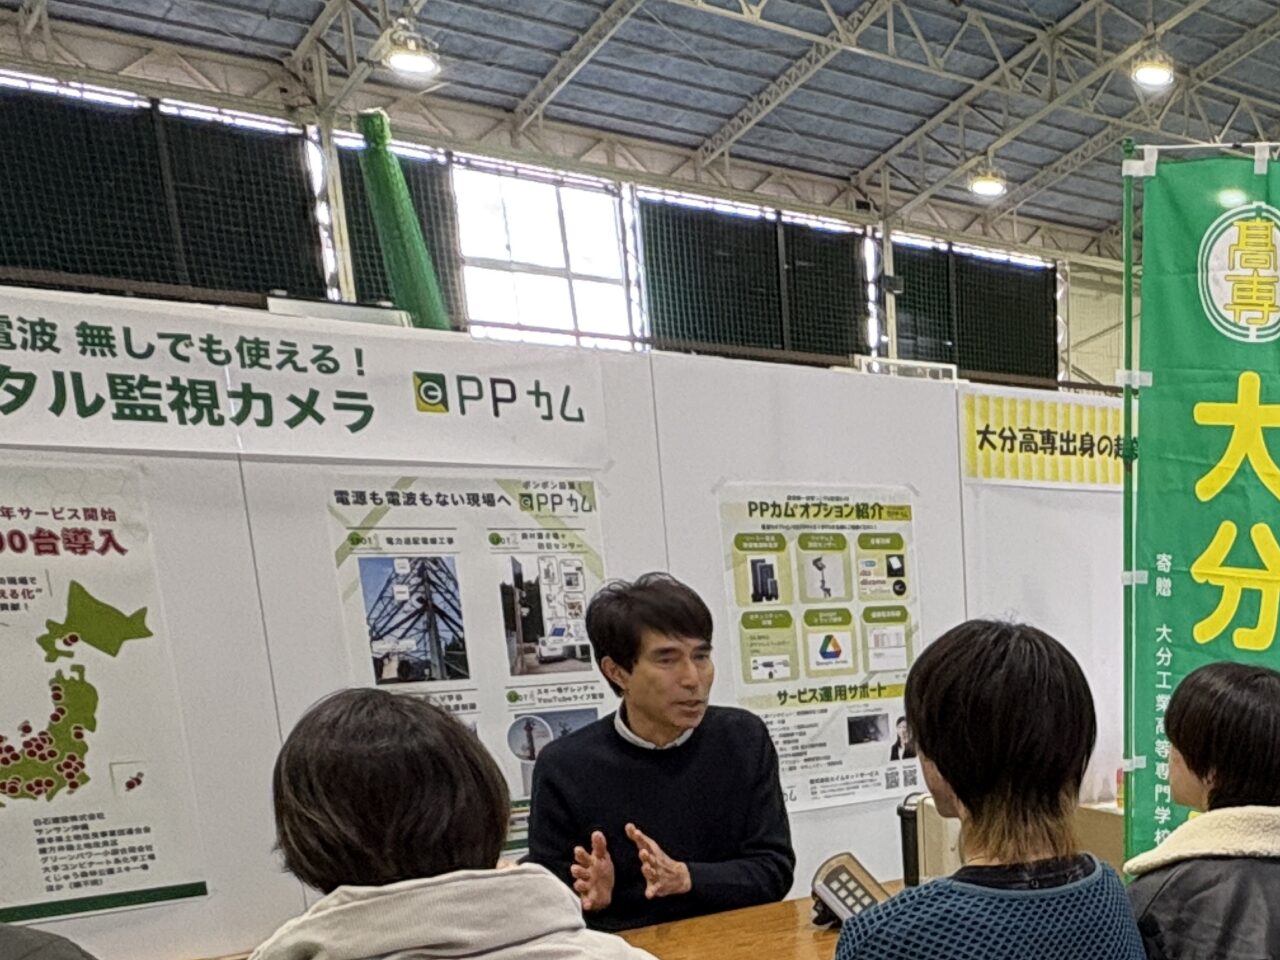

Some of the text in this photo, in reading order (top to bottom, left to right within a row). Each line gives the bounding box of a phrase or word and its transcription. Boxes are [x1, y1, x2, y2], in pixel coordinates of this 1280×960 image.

[75, 321, 367, 376] 無しでも使える！
[0, 363, 375, 433] タル監視カメラ
[0, 505, 117, 522] 年サービス開始
[334, 489, 512, 508] 電源も電波もない現場へ
[0, 526, 129, 556] 0台導入
